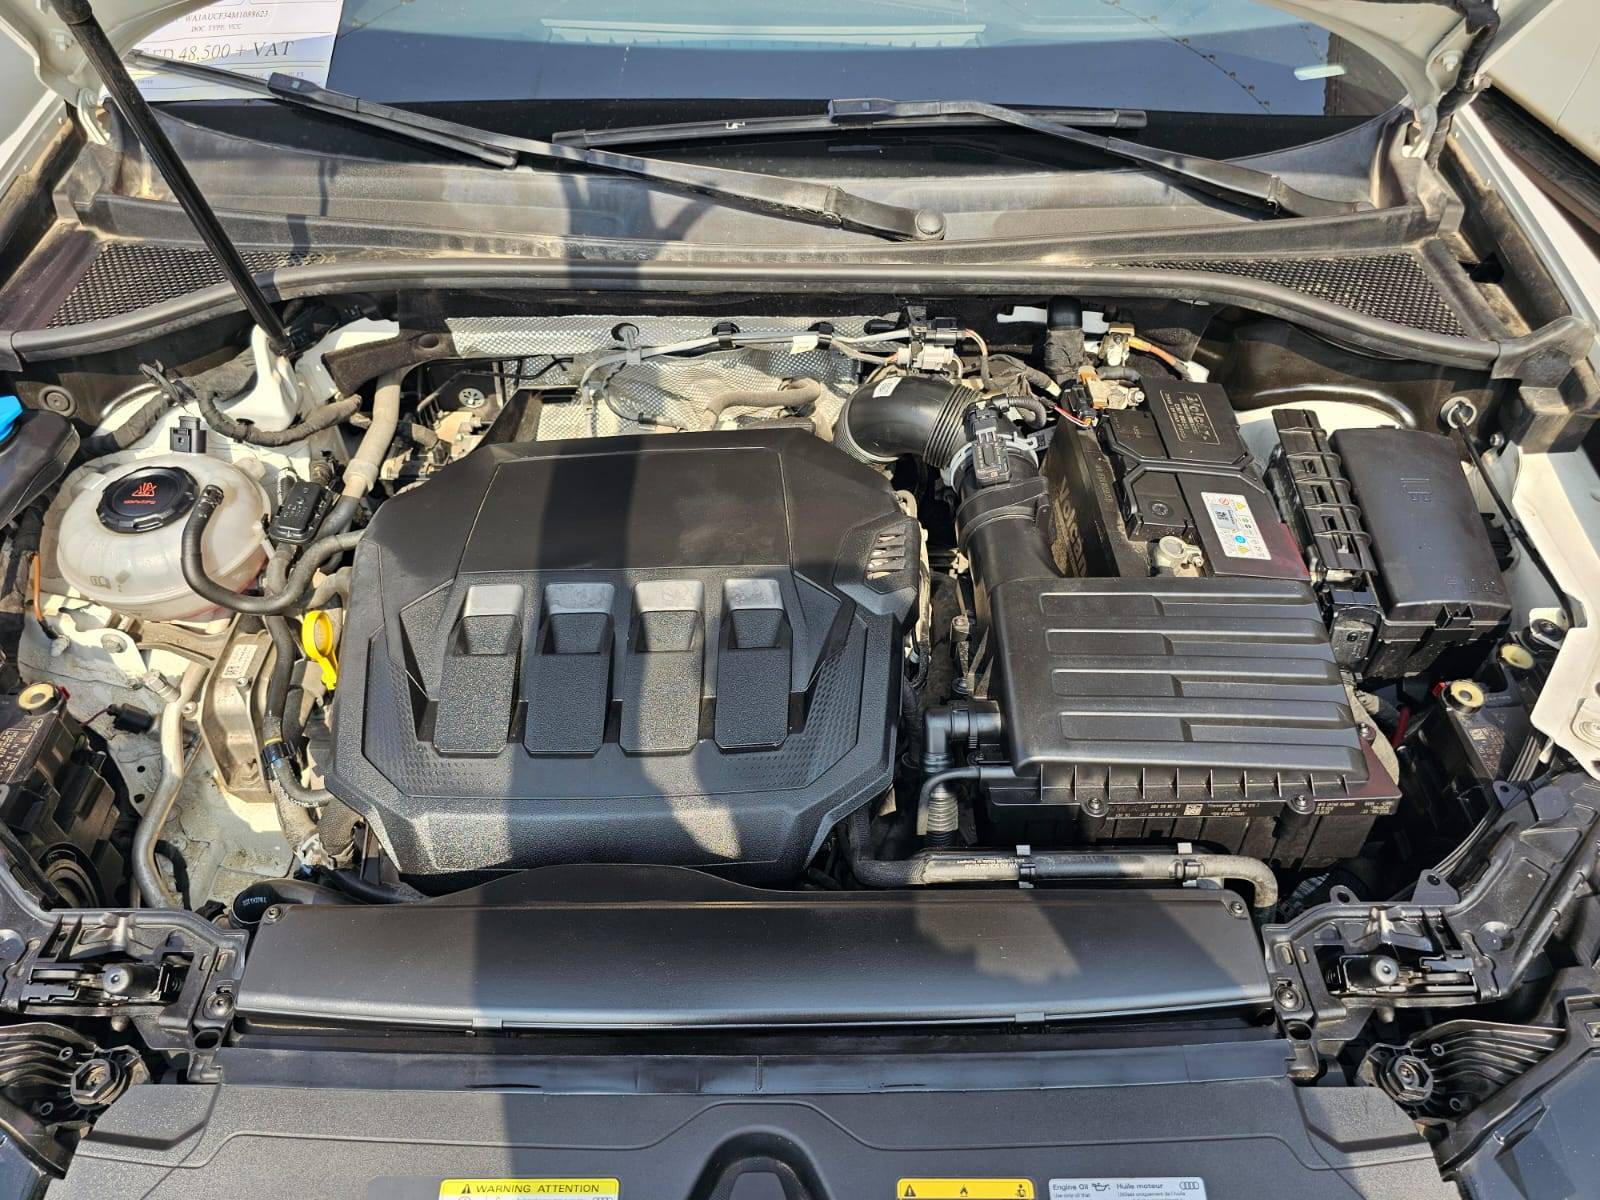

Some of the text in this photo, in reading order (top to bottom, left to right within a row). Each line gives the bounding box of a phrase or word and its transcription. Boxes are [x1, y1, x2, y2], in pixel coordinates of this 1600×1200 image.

[254, 40, 295, 57] VAT
[476, 1183, 600, 1194] WARNING ATTENTION
[1052, 1183, 1077, 1192] Engine
